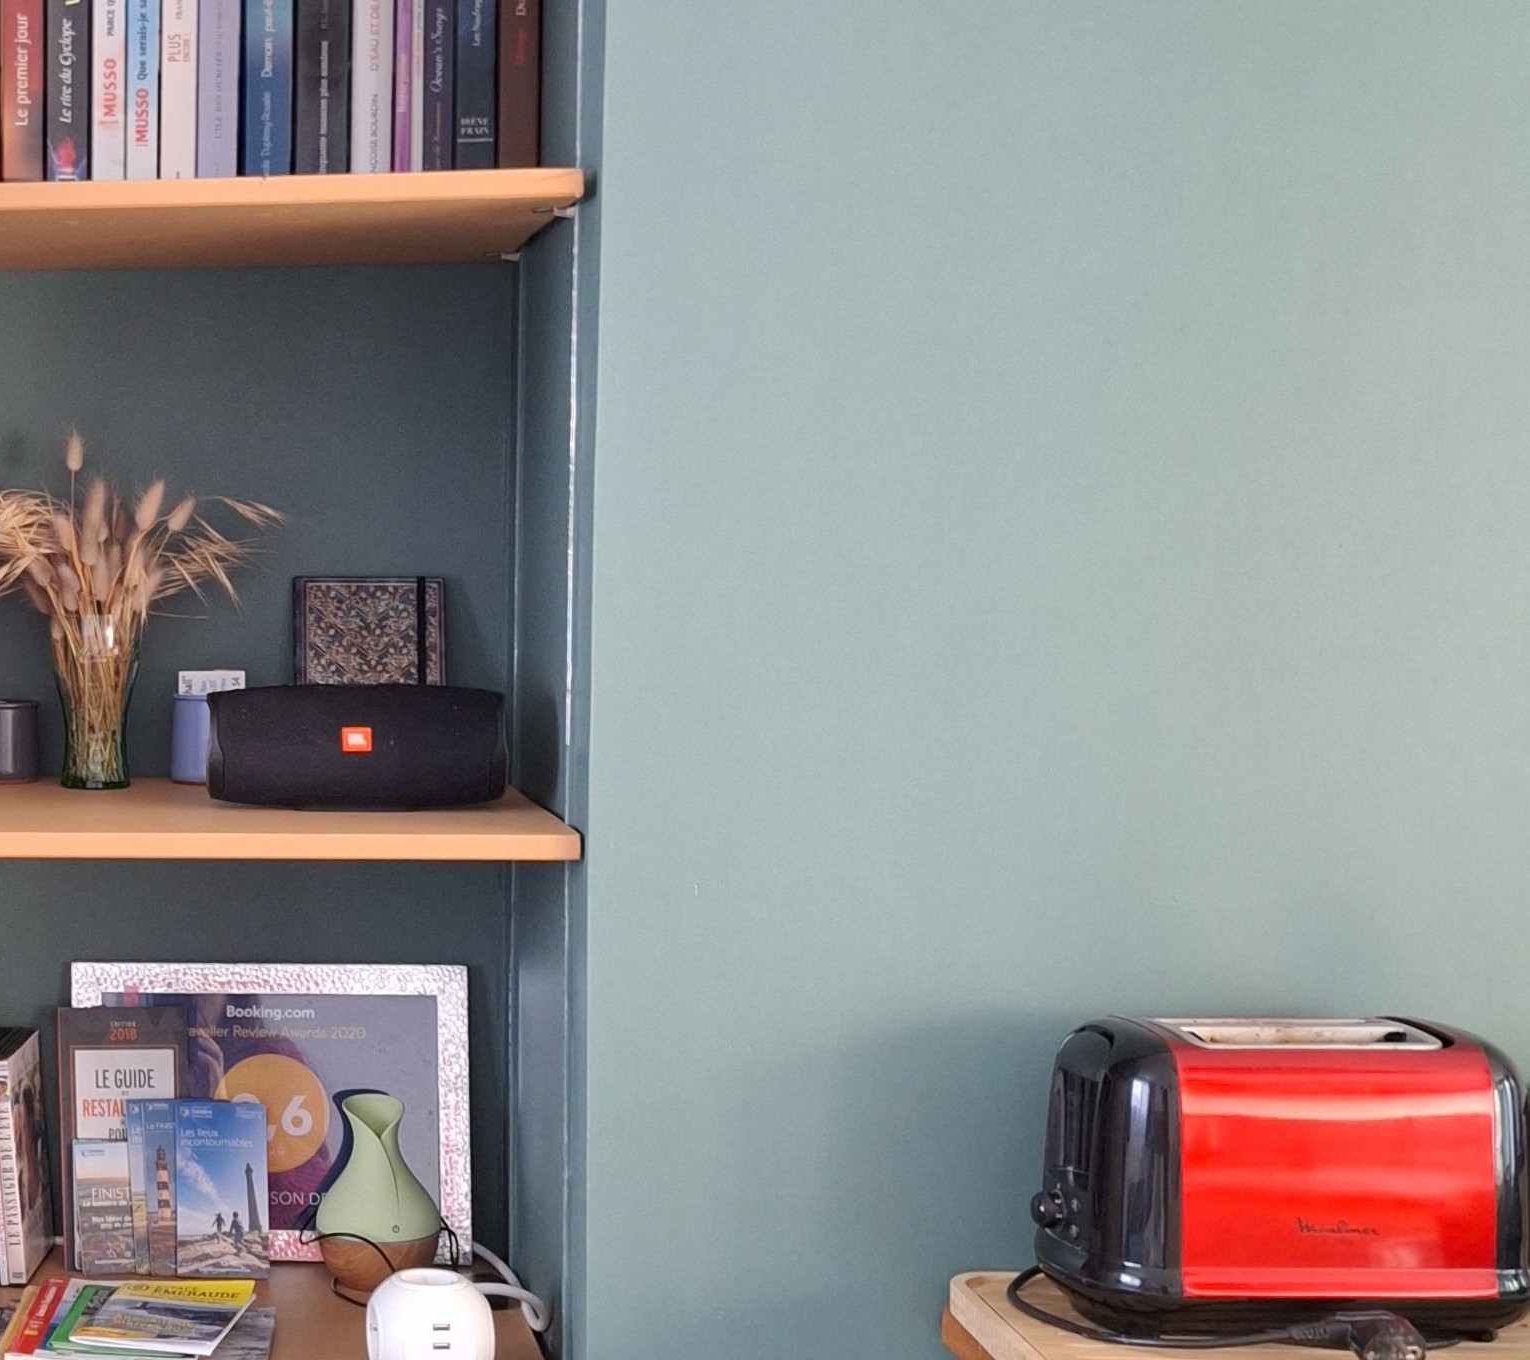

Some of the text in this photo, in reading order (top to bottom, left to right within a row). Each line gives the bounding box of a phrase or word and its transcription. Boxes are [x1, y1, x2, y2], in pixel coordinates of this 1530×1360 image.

[106, 9, 116, 37] PARCE
[371, 4, 380, 20] DE
[136, 12, 149, 57] serais-je
[371, 23, 380, 36] ET
[430, 7, 447, 45] Songs
[167, 33, 181, 63] PLUS
[370, 38, 380, 71] D'EAU
[14, 46, 31, 104] premier
[58, 17, 76, 124] Le rire du Cyclope
[136, 59, 149, 81] Que
[102, 58, 118, 117] MUSSO
[14, 108, 29, 126] Le
[135, 88, 150, 143] MUSSO
[369, 93, 379, 138] BOURDIN
[318, 137, 330, 174] inquante
[226, 1004, 315, 1021] Booking.com
[110, 1028, 137, 1040] 2018
[186, 1025, 366, 1039] aveller Review Awards 2020
[95, 1069, 155, 1089] LE GUIDE
[180, 1128, 219, 1138] Les lieux
[180, 1137, 254, 1148] incontournables
[0, 1145, 13, 1161] DE
[1, 1166, 19, 1227] PASSAGER
[9, 1231, 21, 1246] LE
